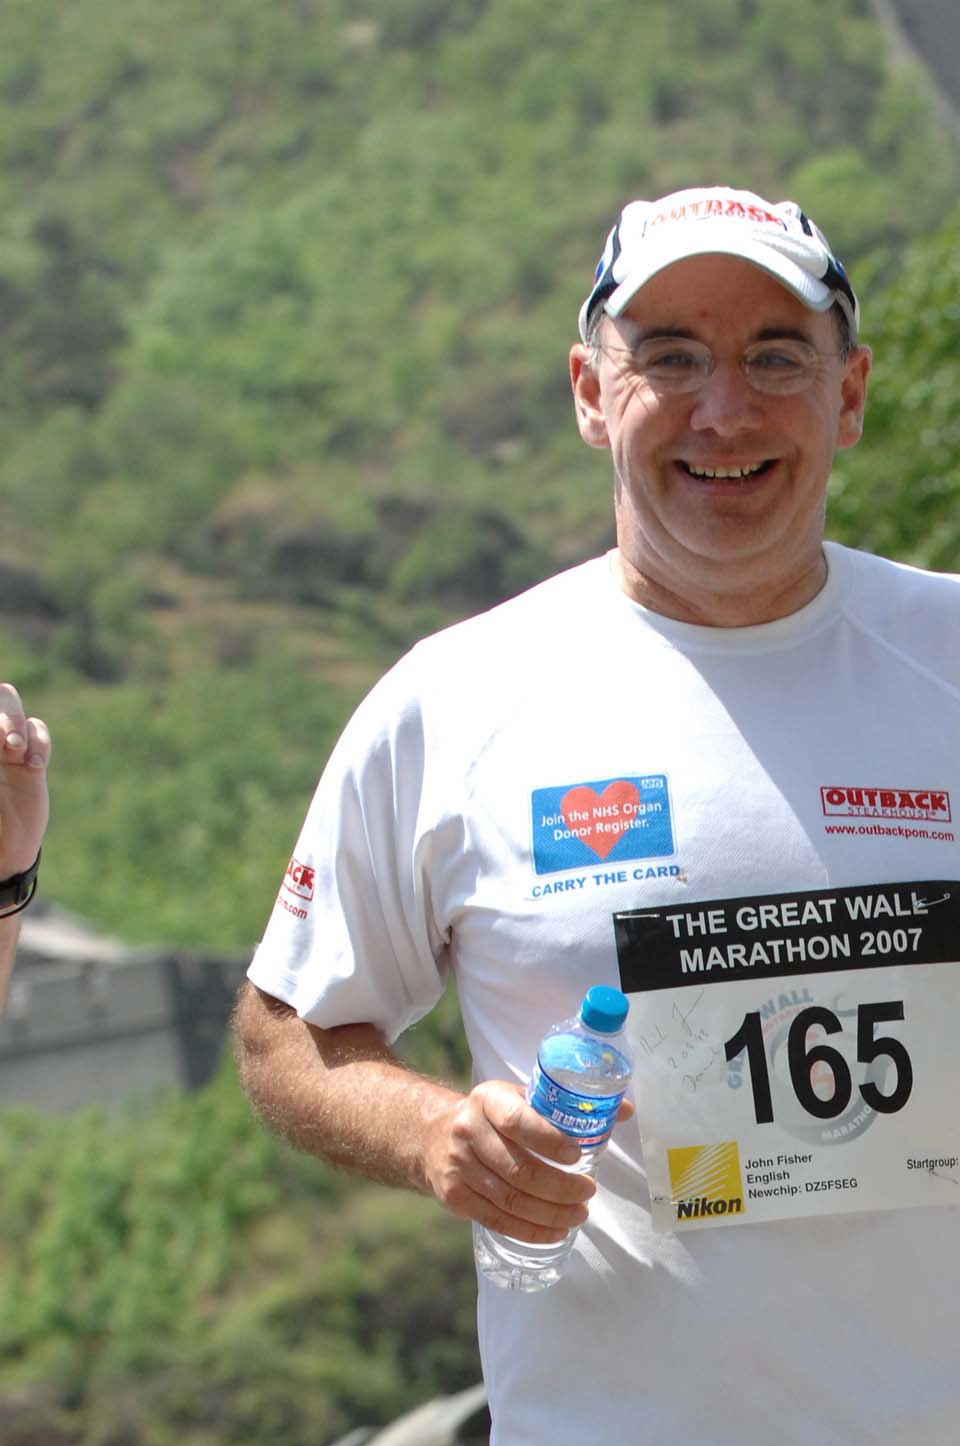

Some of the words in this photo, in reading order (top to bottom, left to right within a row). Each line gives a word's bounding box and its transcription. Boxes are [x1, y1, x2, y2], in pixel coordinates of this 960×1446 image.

[825, 788, 947, 812] OUTBACK
[541, 814, 565, 827] Join
[568, 809, 589, 823] the
[592, 803, 620, 817] NHS
[622, 801, 662, 816] Organ
[553, 825, 592, 841] Donor
[595, 817, 650, 835] Register.
[824, 824, 955, 842] www.outbackpom.com
[532, 876, 587, 898] CARRY
[592, 870, 628, 886] THE
[632, 864, 681, 880] CARD
[666, 909, 727, 938] THE
[736, 898, 837, 931] GREAT
[845, 891, 929, 921] WALL
[679, 933, 850, 974] MARATHON
[859, 927, 923, 956] 2007
[724, 1000, 913, 1125] 165
[745, 1157, 774, 1170] John
[777, 1153, 813, 1165] Fisher
[906, 1157, 959, 1171] Startgroup:
[746, 1170, 790, 1185] English
[748, 1185, 802, 1200] Newchip:
[805, 1177, 858, 1193] DZ5FSEG
[677, 1197, 742, 1220] Nikon
